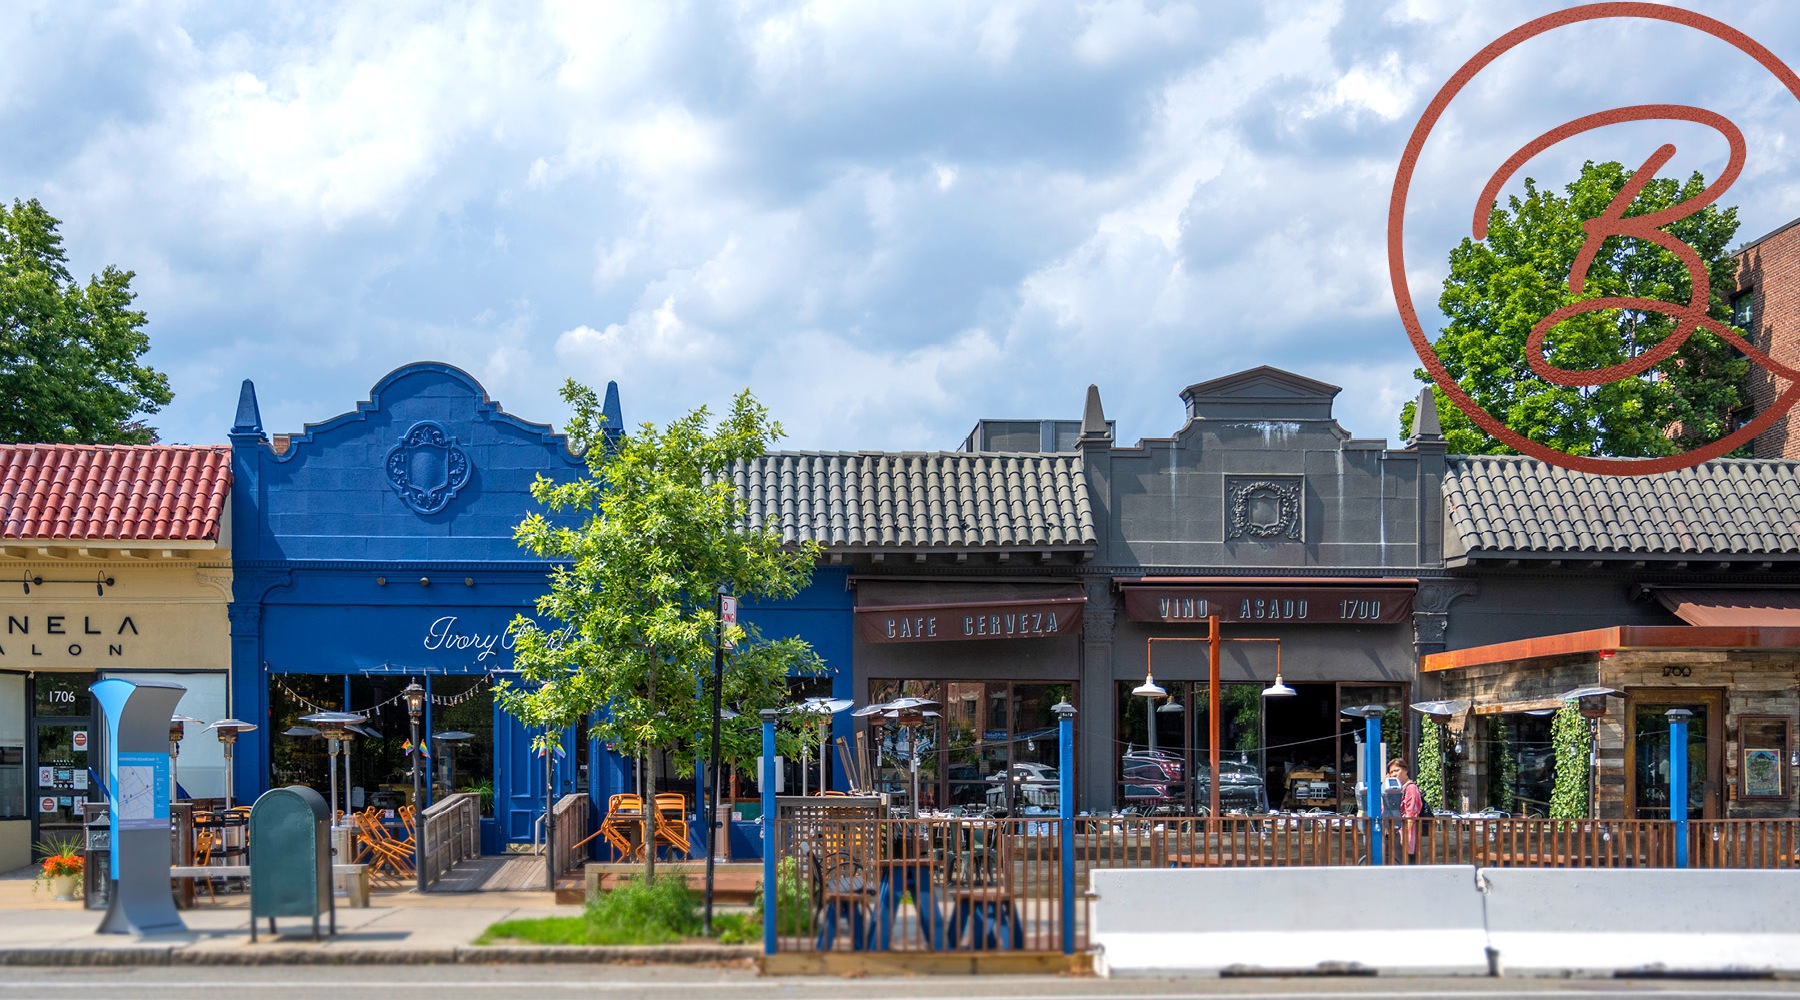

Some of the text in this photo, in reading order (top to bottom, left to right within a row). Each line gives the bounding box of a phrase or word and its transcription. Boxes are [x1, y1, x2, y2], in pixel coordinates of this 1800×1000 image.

[1158, 598, 1380, 619] VINO ASADO 1700
[885, 611, 1058, 639] CAFE CERVEZA
[424, 616, 498, 662] Ivory
[49, 691, 76, 703] 1706
